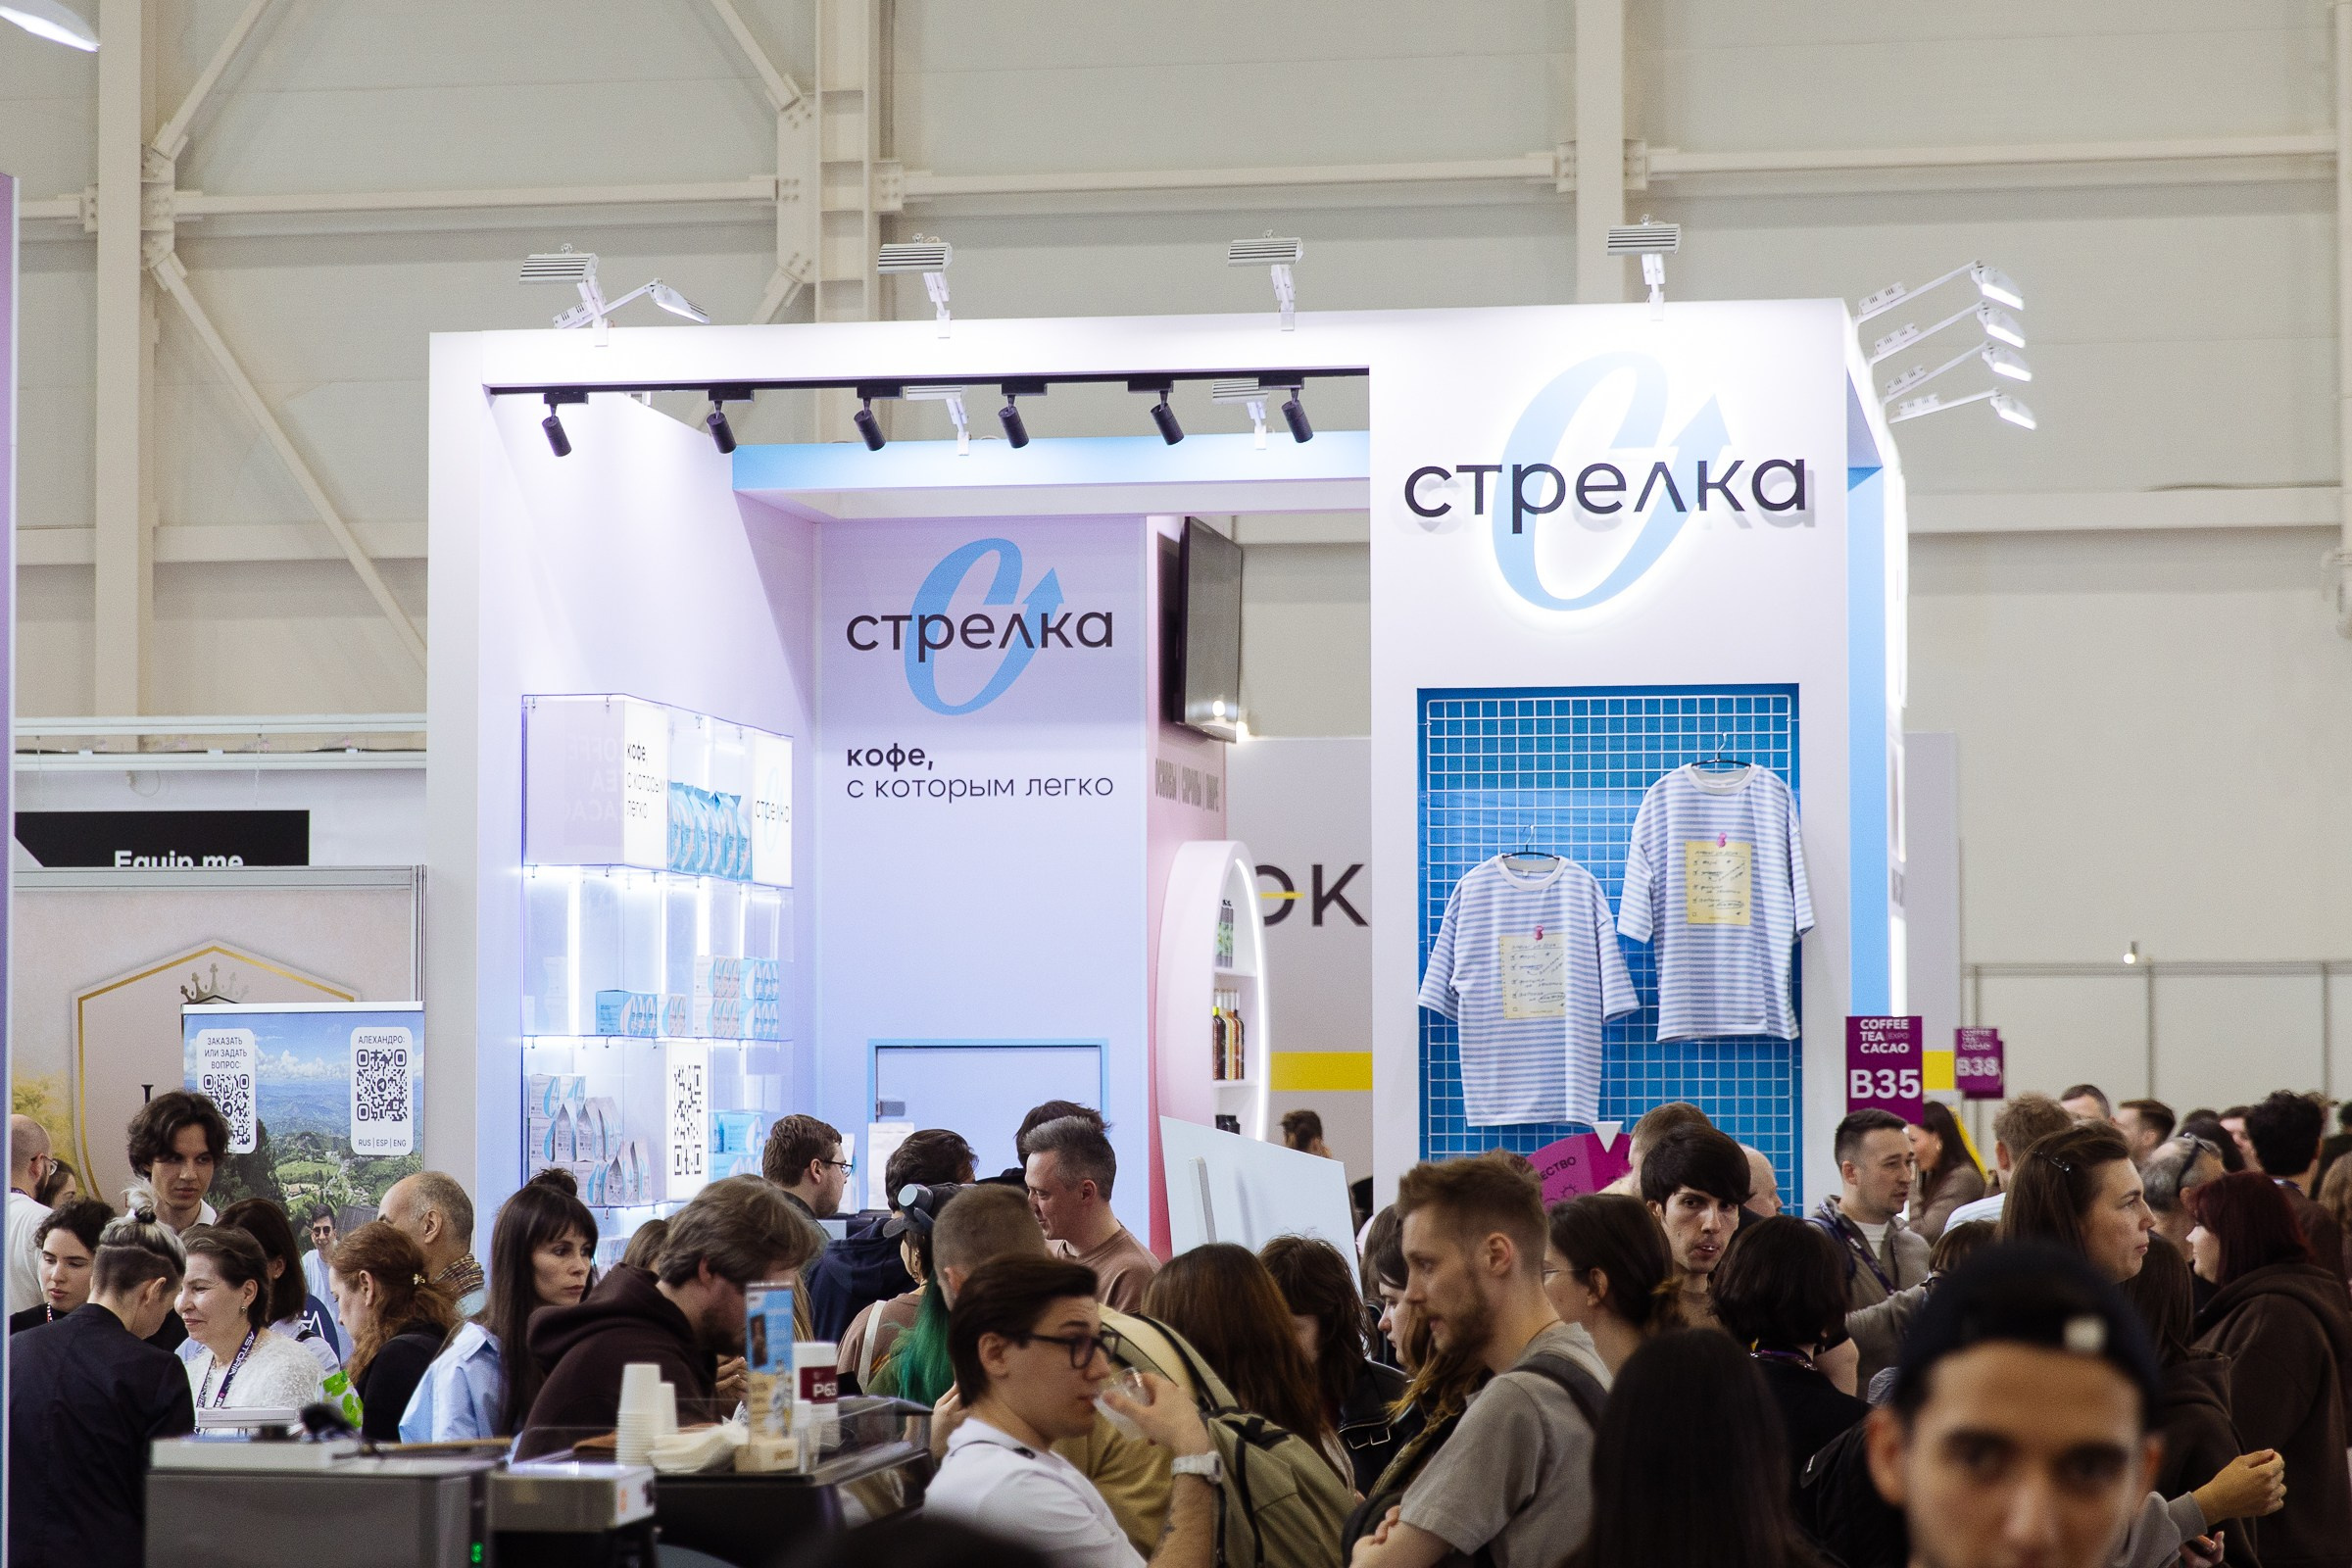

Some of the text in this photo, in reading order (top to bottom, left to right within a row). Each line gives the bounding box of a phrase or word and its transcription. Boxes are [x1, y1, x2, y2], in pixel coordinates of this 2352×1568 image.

[1403, 458, 1806, 534] стрелка
[846, 611, 1114, 663] стрелка
[846, 743, 934, 772] кофе,
[846, 776, 1114, 804] с которым легко
[203, 855, 244, 868] me
[1859, 1018, 1909, 1030] COFFEE
[207, 1037, 243, 1046] ЗАКАЗАТЬ
[359, 1035, 406, 1046] АЛЕХАНДРО:
[1859, 1031, 1886, 1042] TEA
[204, 1049, 248, 1058] ИЛИ ЗАДАТЬ
[1860, 1043, 1910, 1054] CACAO
[211, 1060, 242, 1069] ВОПРОС:
[1956, 1056, 1999, 1077] B38
[1850, 1068, 1921, 1100] B35
[228, 1331, 255, 1376] ASTORIA
